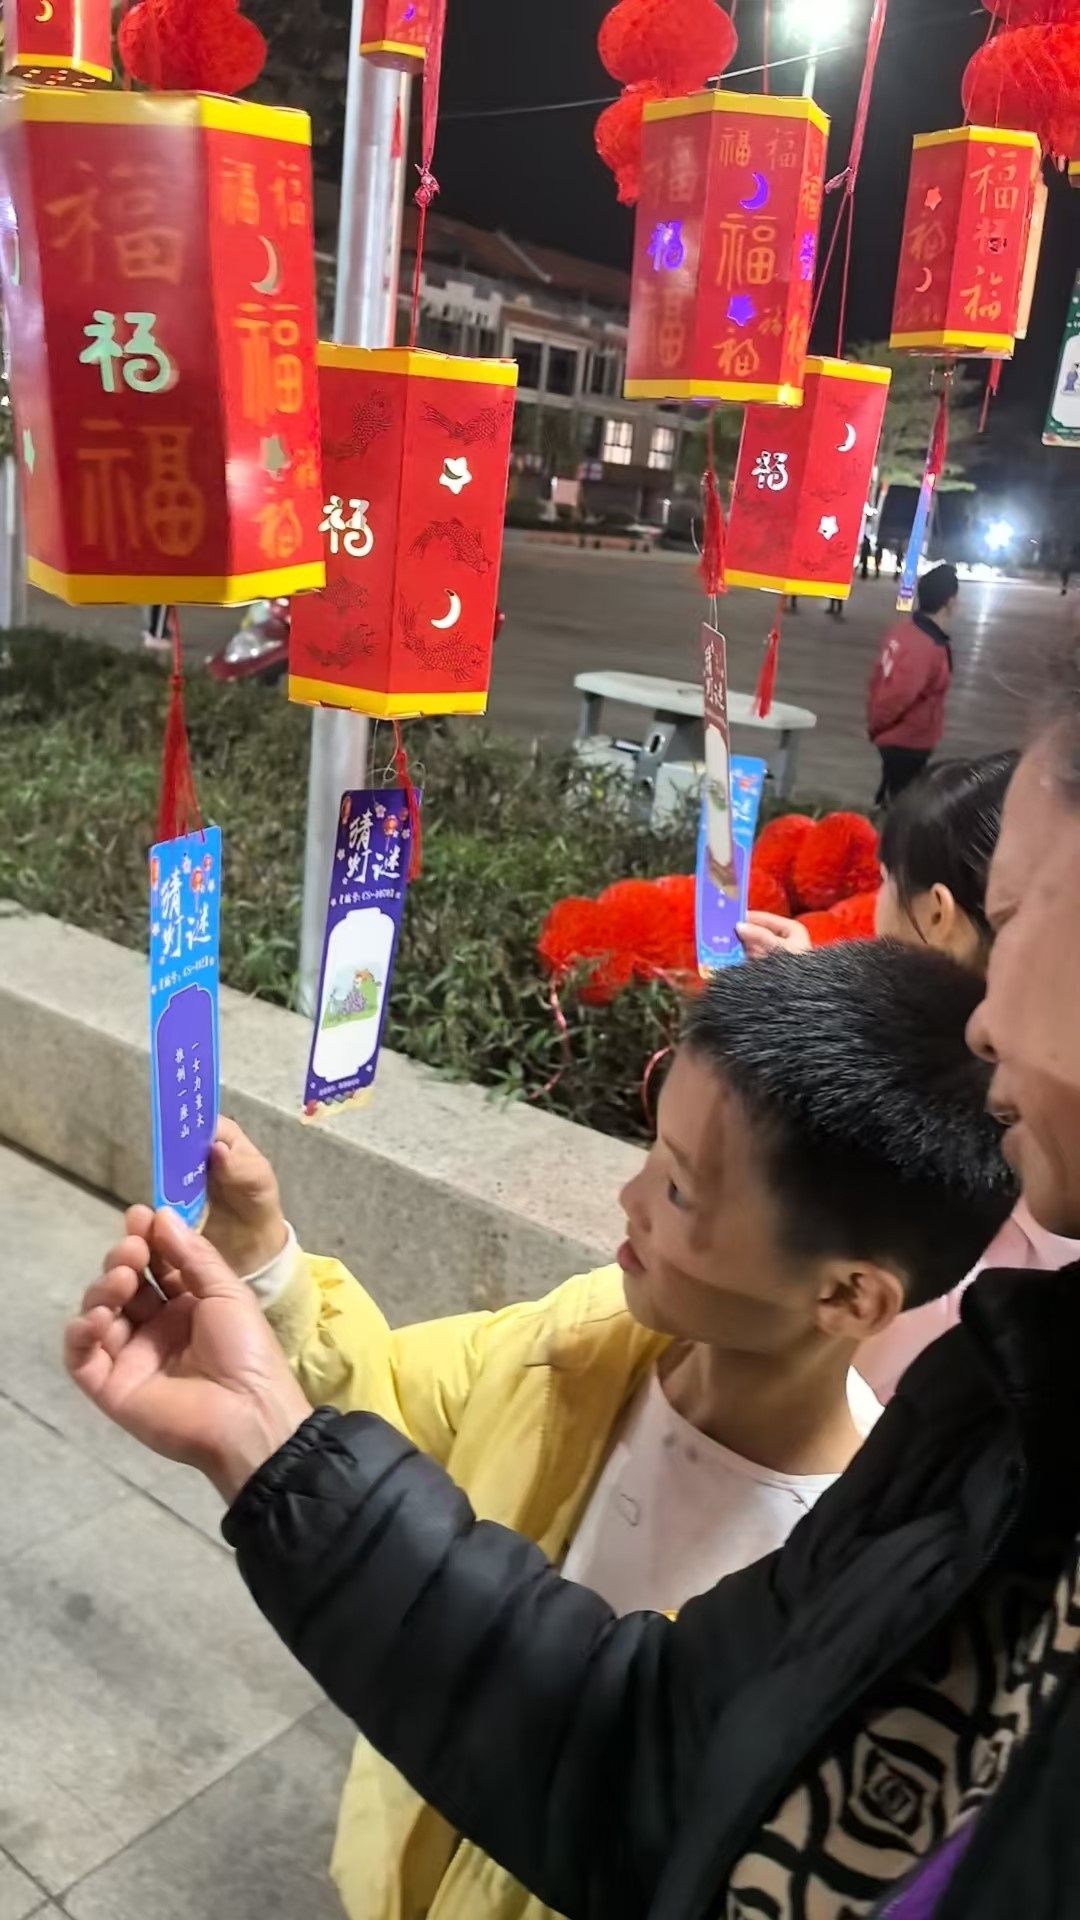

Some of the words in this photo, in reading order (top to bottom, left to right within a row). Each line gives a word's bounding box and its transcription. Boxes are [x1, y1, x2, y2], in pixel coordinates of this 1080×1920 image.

[720, 127, 750, 167] 福
[766, 127, 797, 171] 福
[969, 146, 1018, 214] 福
[45, 158, 184, 287] 福
[716, 213, 779, 291] 福
[79, 309, 172, 393] 福
[234, 302, 304, 427] 福
[713, 327, 760, 378] 福
[76, 418, 205, 561] 福
[751, 450, 789, 491] 福
[318, 494, 375, 558] 福
